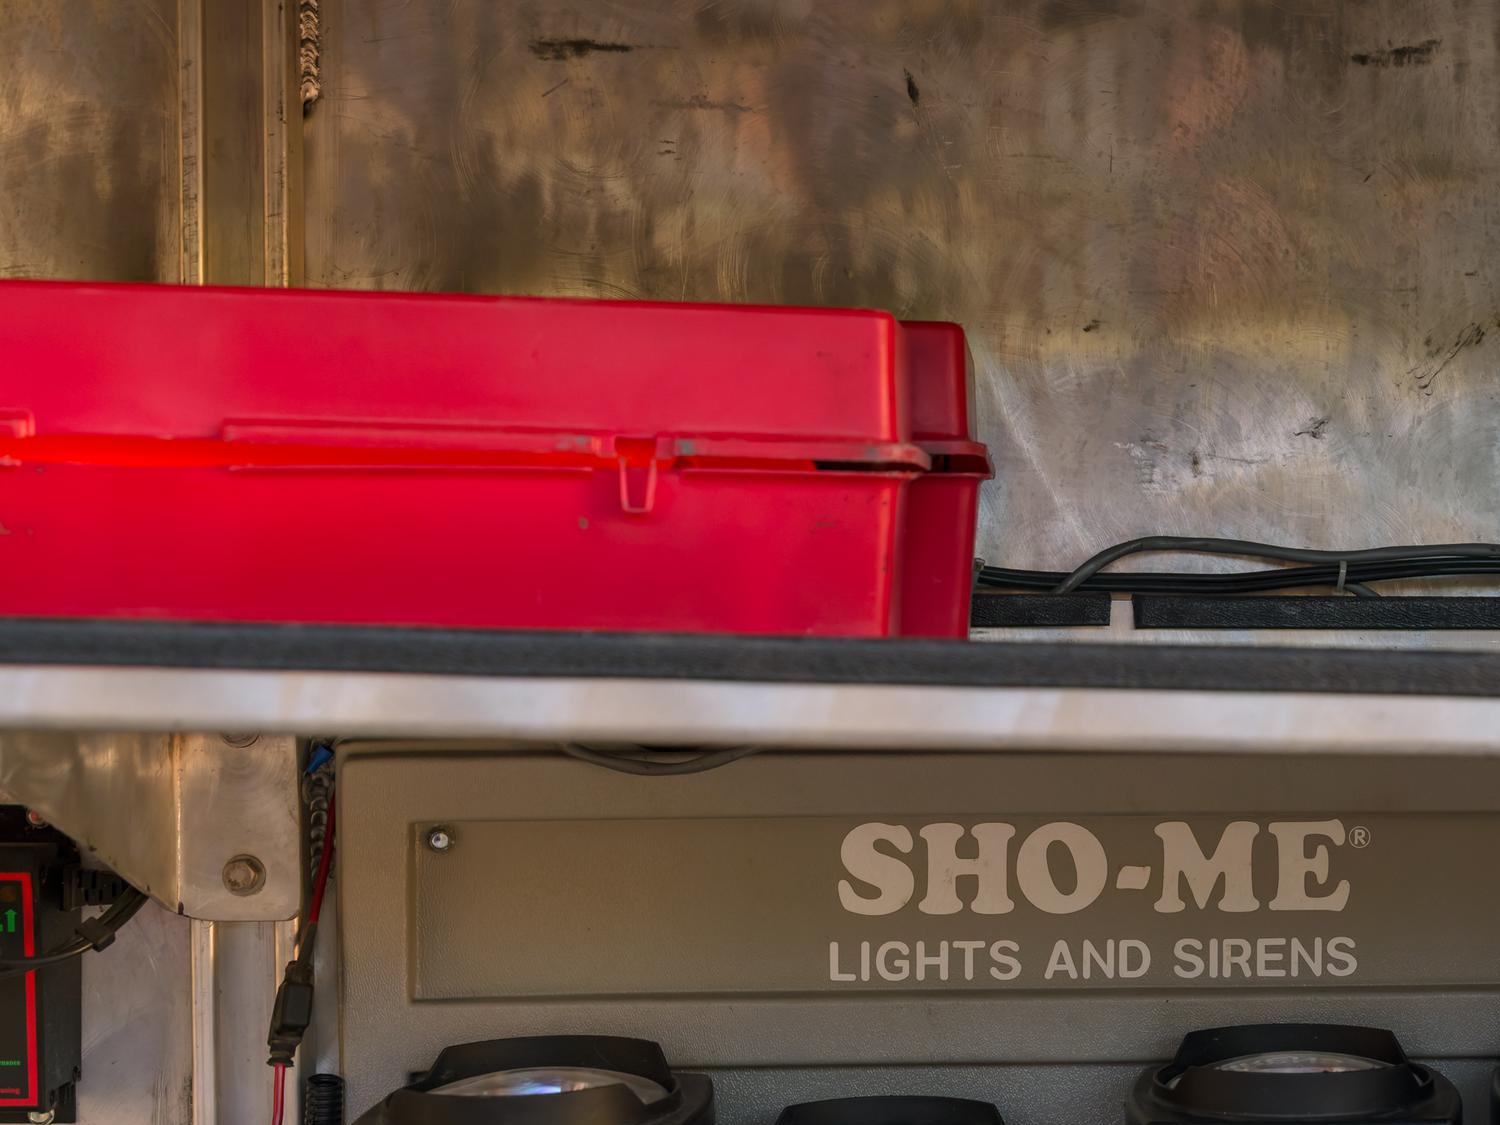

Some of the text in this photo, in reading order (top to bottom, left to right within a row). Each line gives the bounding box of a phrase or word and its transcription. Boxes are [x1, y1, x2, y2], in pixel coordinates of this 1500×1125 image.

[829, 937, 1358, 981] LIGHTS AND SIRENS
